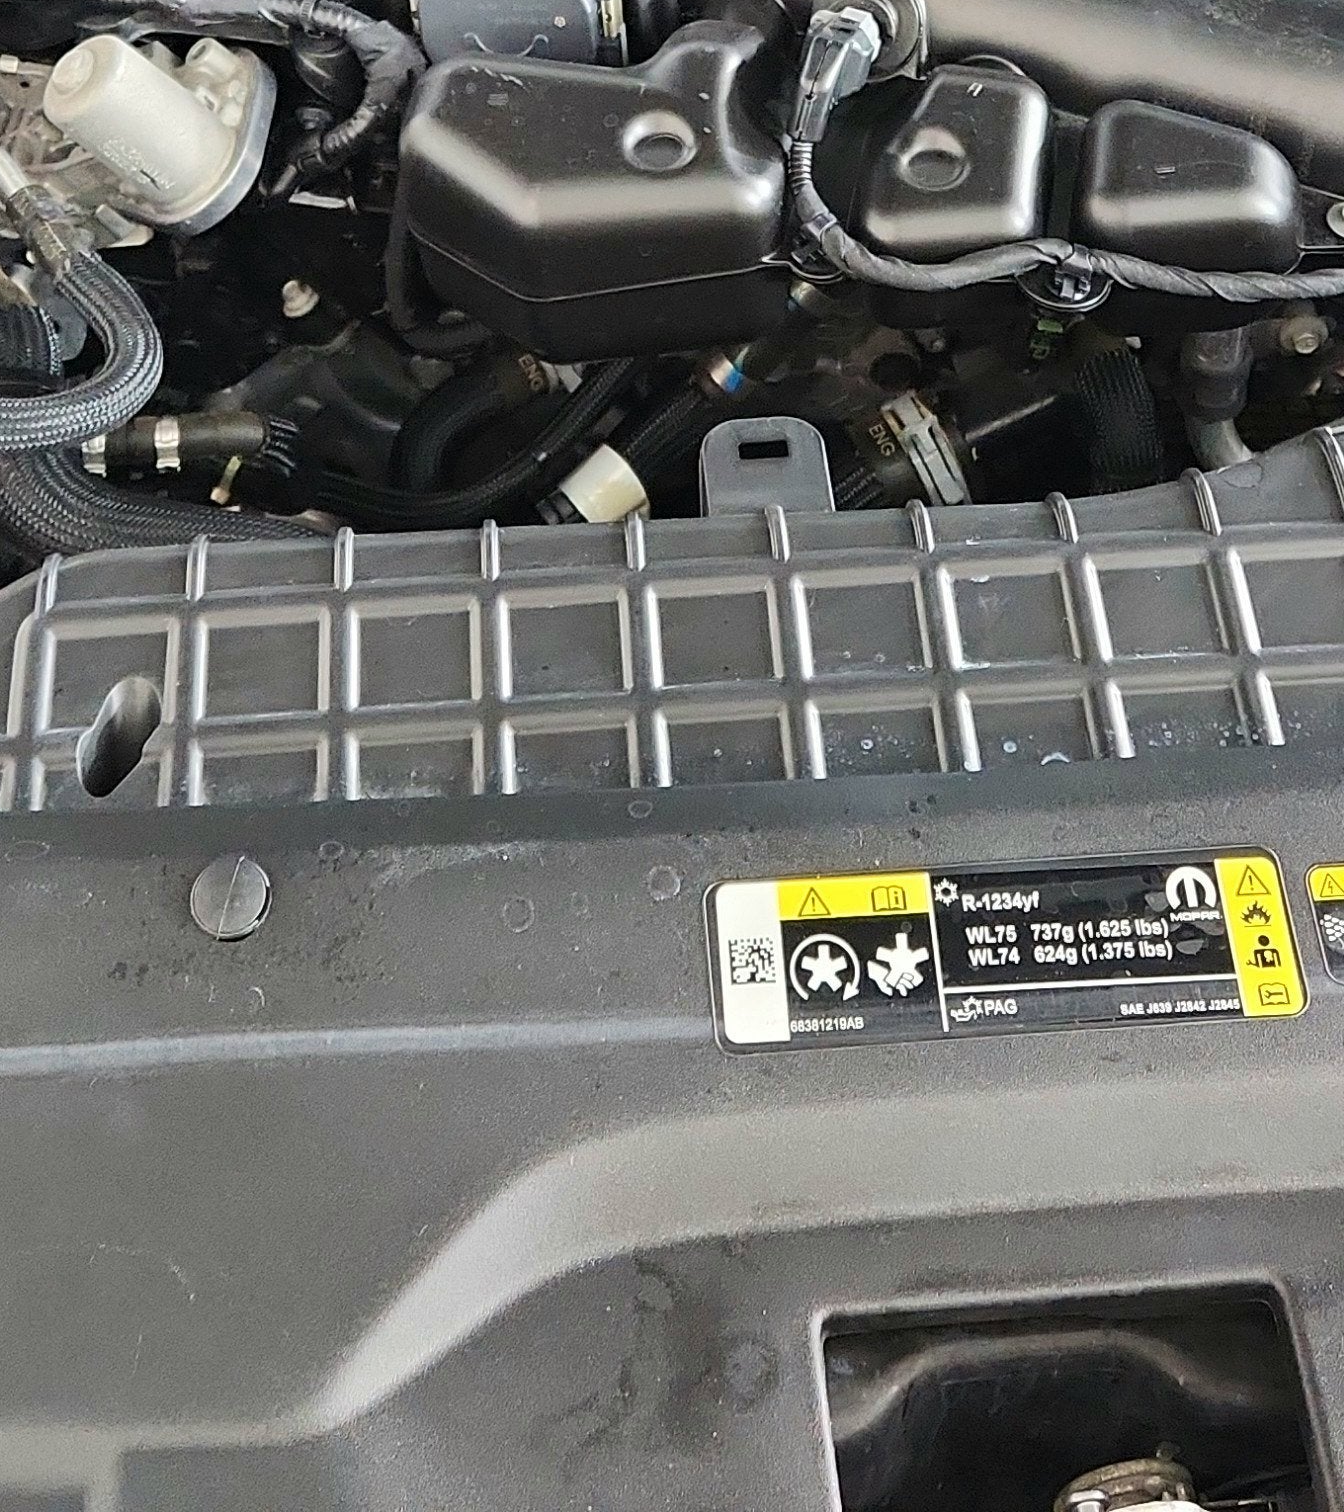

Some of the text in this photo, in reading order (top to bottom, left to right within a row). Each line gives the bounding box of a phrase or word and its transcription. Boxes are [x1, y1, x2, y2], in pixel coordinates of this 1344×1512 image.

[868, 423, 896, 457] ENG
[961, 890, 1040, 913] R-1234yf
[965, 917, 1169, 945] WL75 737g (1.625 lbs)
[968, 939, 1173, 967] WL74 624g (1.375 lbs)
[984, 998, 1019, 1017] PAG
[1119, 1002, 1145, 1016] SAE
